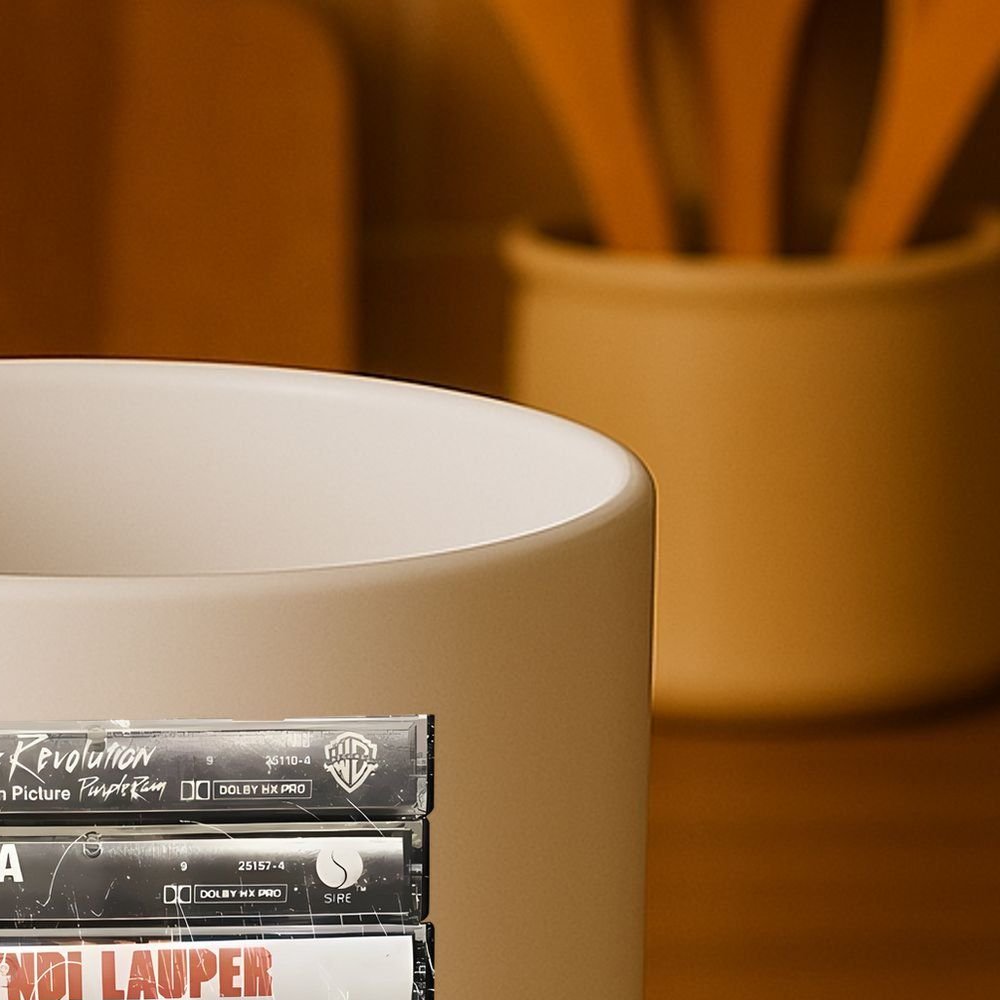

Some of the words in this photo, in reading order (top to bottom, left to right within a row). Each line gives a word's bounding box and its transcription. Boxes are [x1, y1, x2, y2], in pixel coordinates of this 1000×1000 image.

[206, 755, 215, 766] 9
[12, 785, 71, 802] Picture
[219, 784, 258, 796] DOLBY
[261, 783, 279, 796] HX
[280, 782, 306, 795] PRO
[180, 861, 188, 872] 9
[238, 860, 285, 872] 25157-4
[258, 888, 282, 899] PRO
[324, 892, 352, 905] SIRE
[101, 946, 273, 1000] LAUPER
